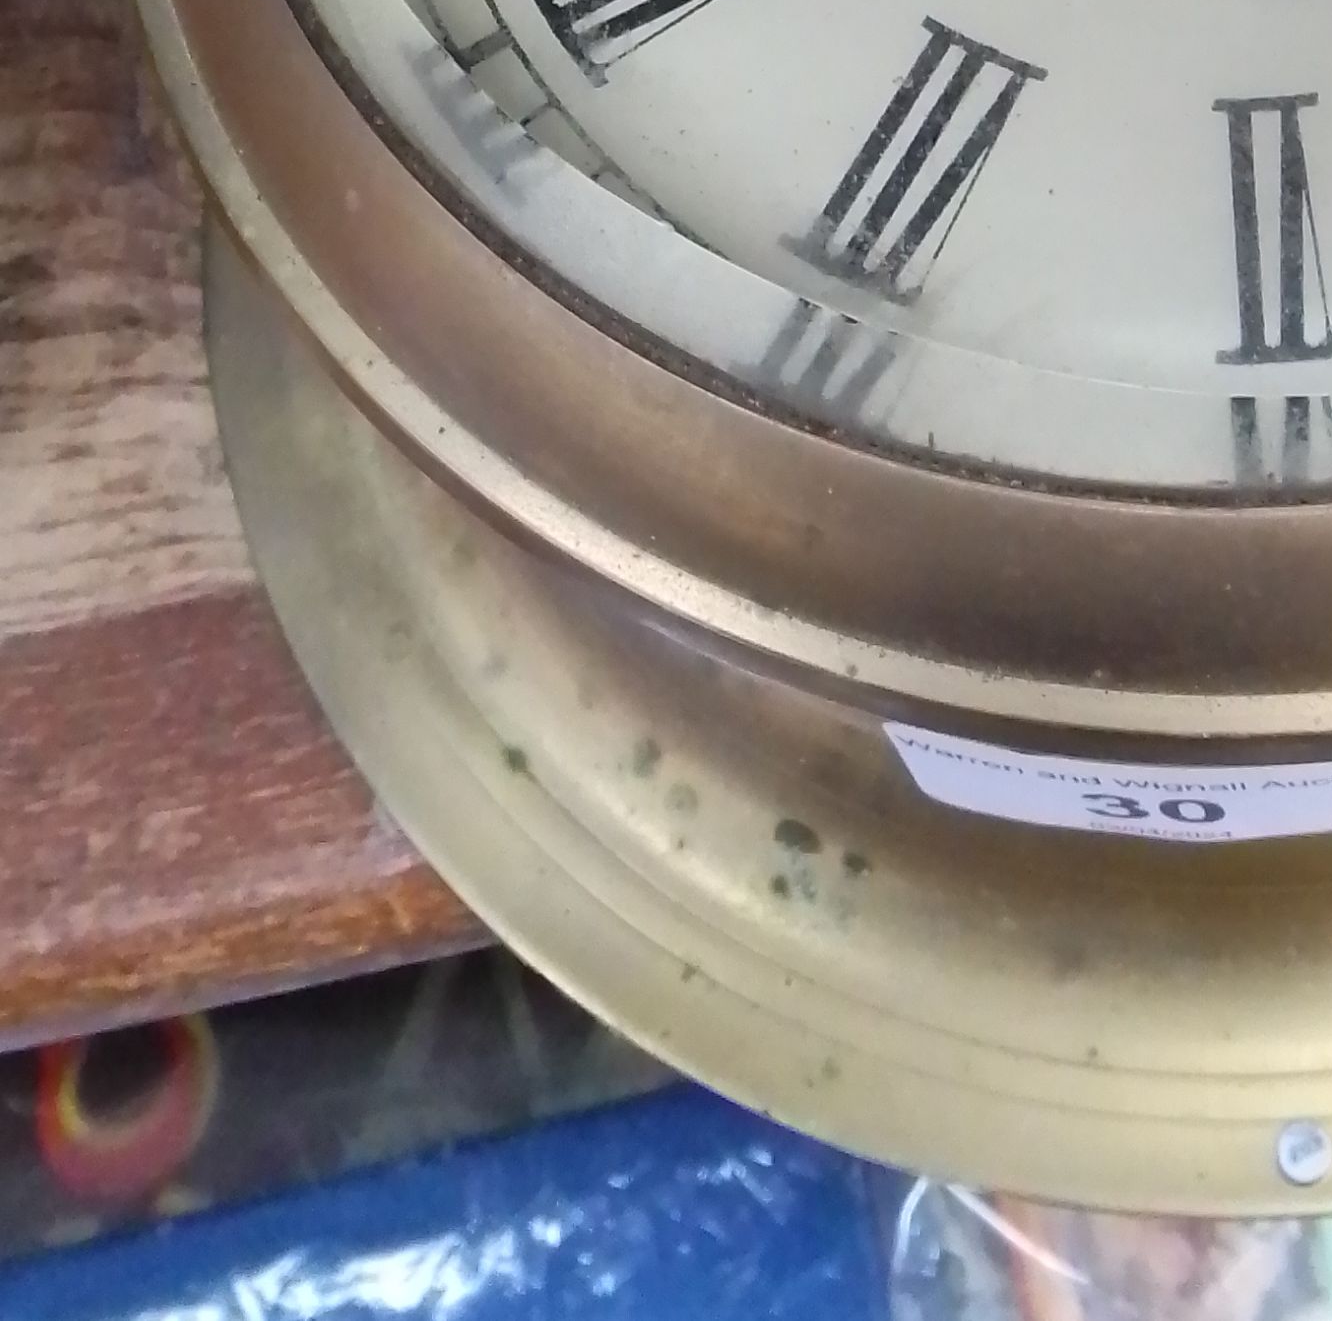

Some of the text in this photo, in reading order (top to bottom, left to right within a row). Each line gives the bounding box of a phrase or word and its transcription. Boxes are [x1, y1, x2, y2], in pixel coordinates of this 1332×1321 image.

[778, 15, 1048, 307] VII
[895, 734, 1024, 775] Warren
[1036, 769, 1102, 786] and
[1112, 778, 1247, 793] Wignall
[1082, 794, 1226, 823] 30
